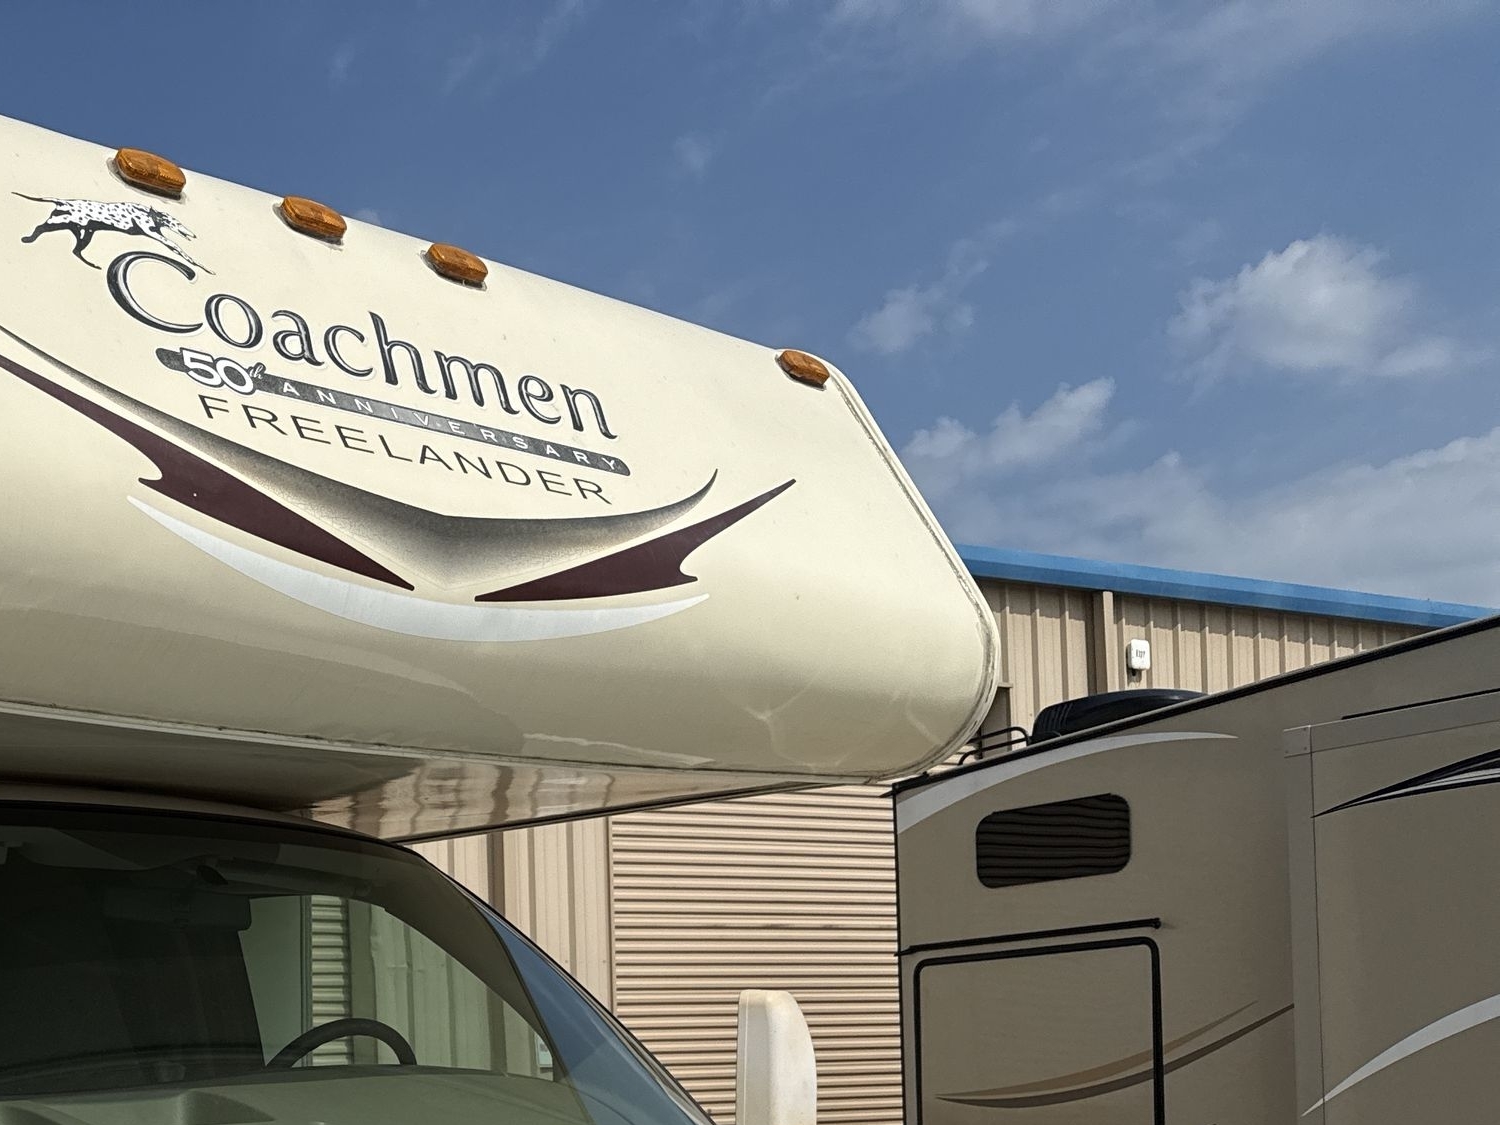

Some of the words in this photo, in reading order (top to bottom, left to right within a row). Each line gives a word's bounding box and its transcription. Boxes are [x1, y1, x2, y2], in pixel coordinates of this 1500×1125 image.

[106, 250, 618, 440] Coachmen
[180, 348, 266, 395] 50th
[283, 381, 616, 470] ANNIVERSARY
[198, 394, 612, 505] FREELANDER
